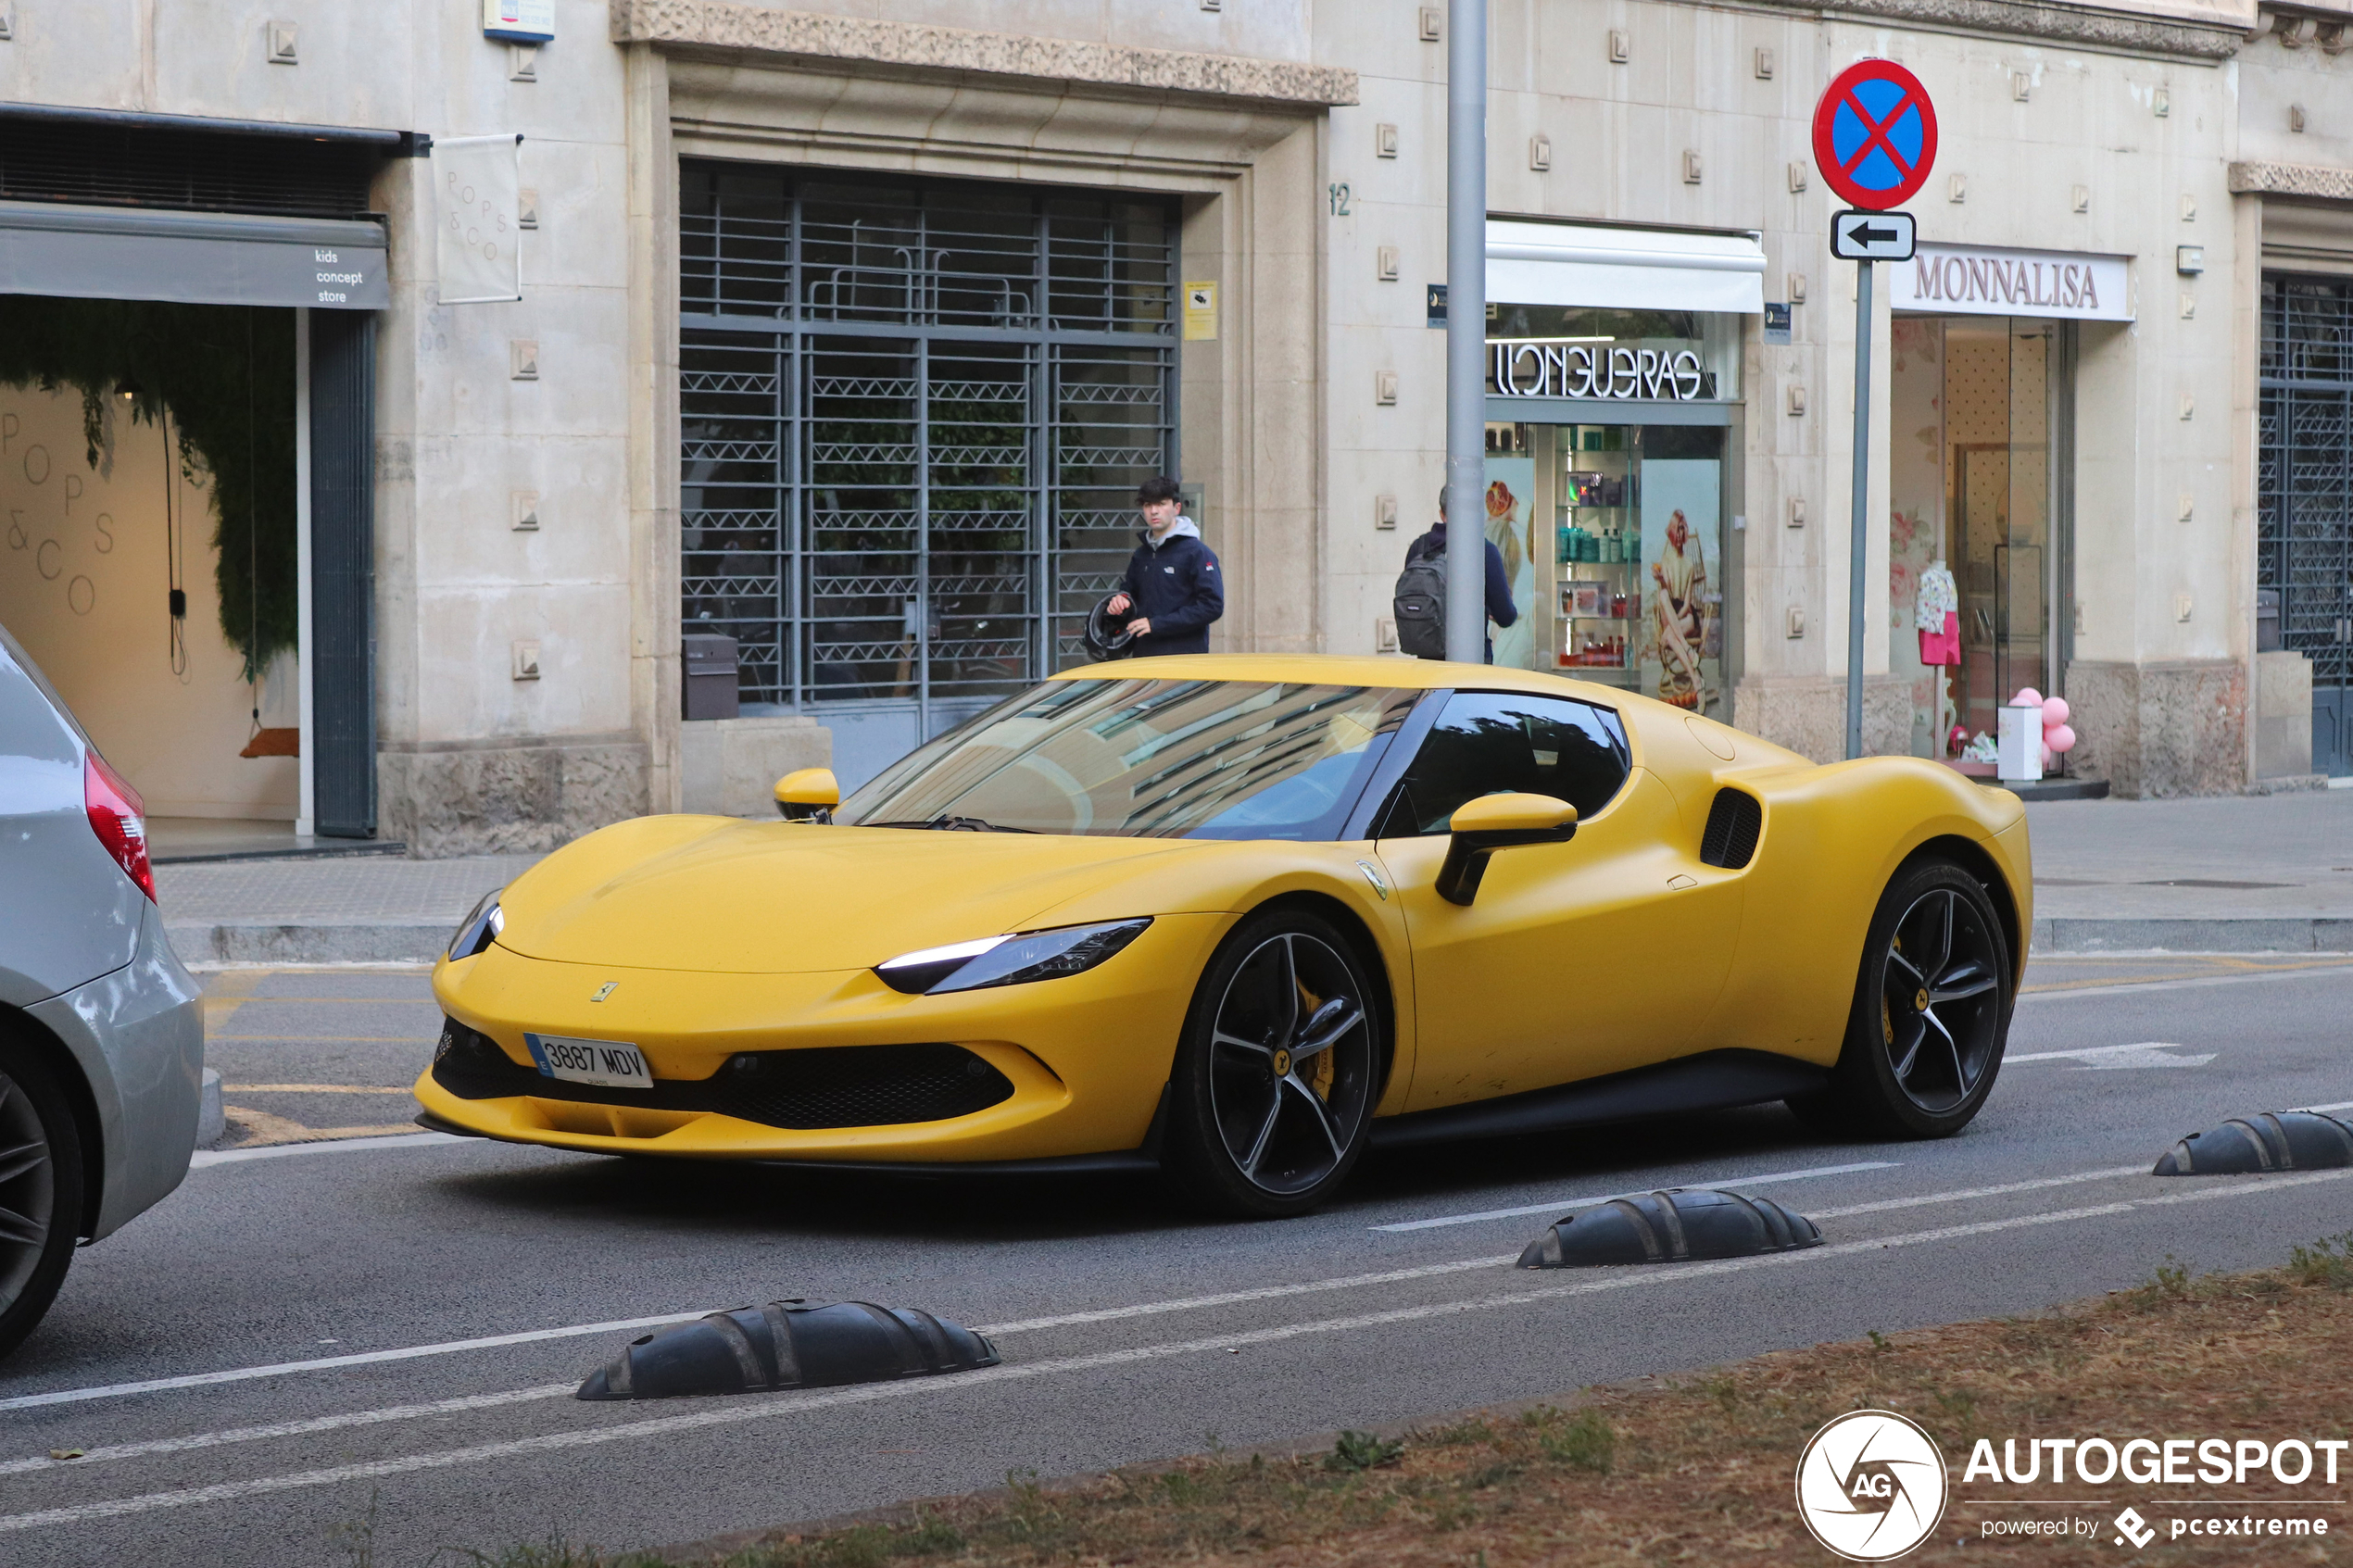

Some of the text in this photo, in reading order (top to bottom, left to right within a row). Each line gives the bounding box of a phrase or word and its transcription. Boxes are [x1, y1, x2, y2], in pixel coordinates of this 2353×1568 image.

[447, 171, 507, 233] POPS
[1329, 182, 1351, 216] 12
[315, 249, 338, 263] kids
[316, 271, 363, 287] concept
[1914, 254, 2099, 308] MONNALISA
[318, 290, 346, 303] store
[1494, 344, 1701, 401] LLONGUERAS
[2, 413, 114, 554] POPS
[539, 1060, 547, 1070] E
[544, 1043, 643, 1076] 3887 MDV
